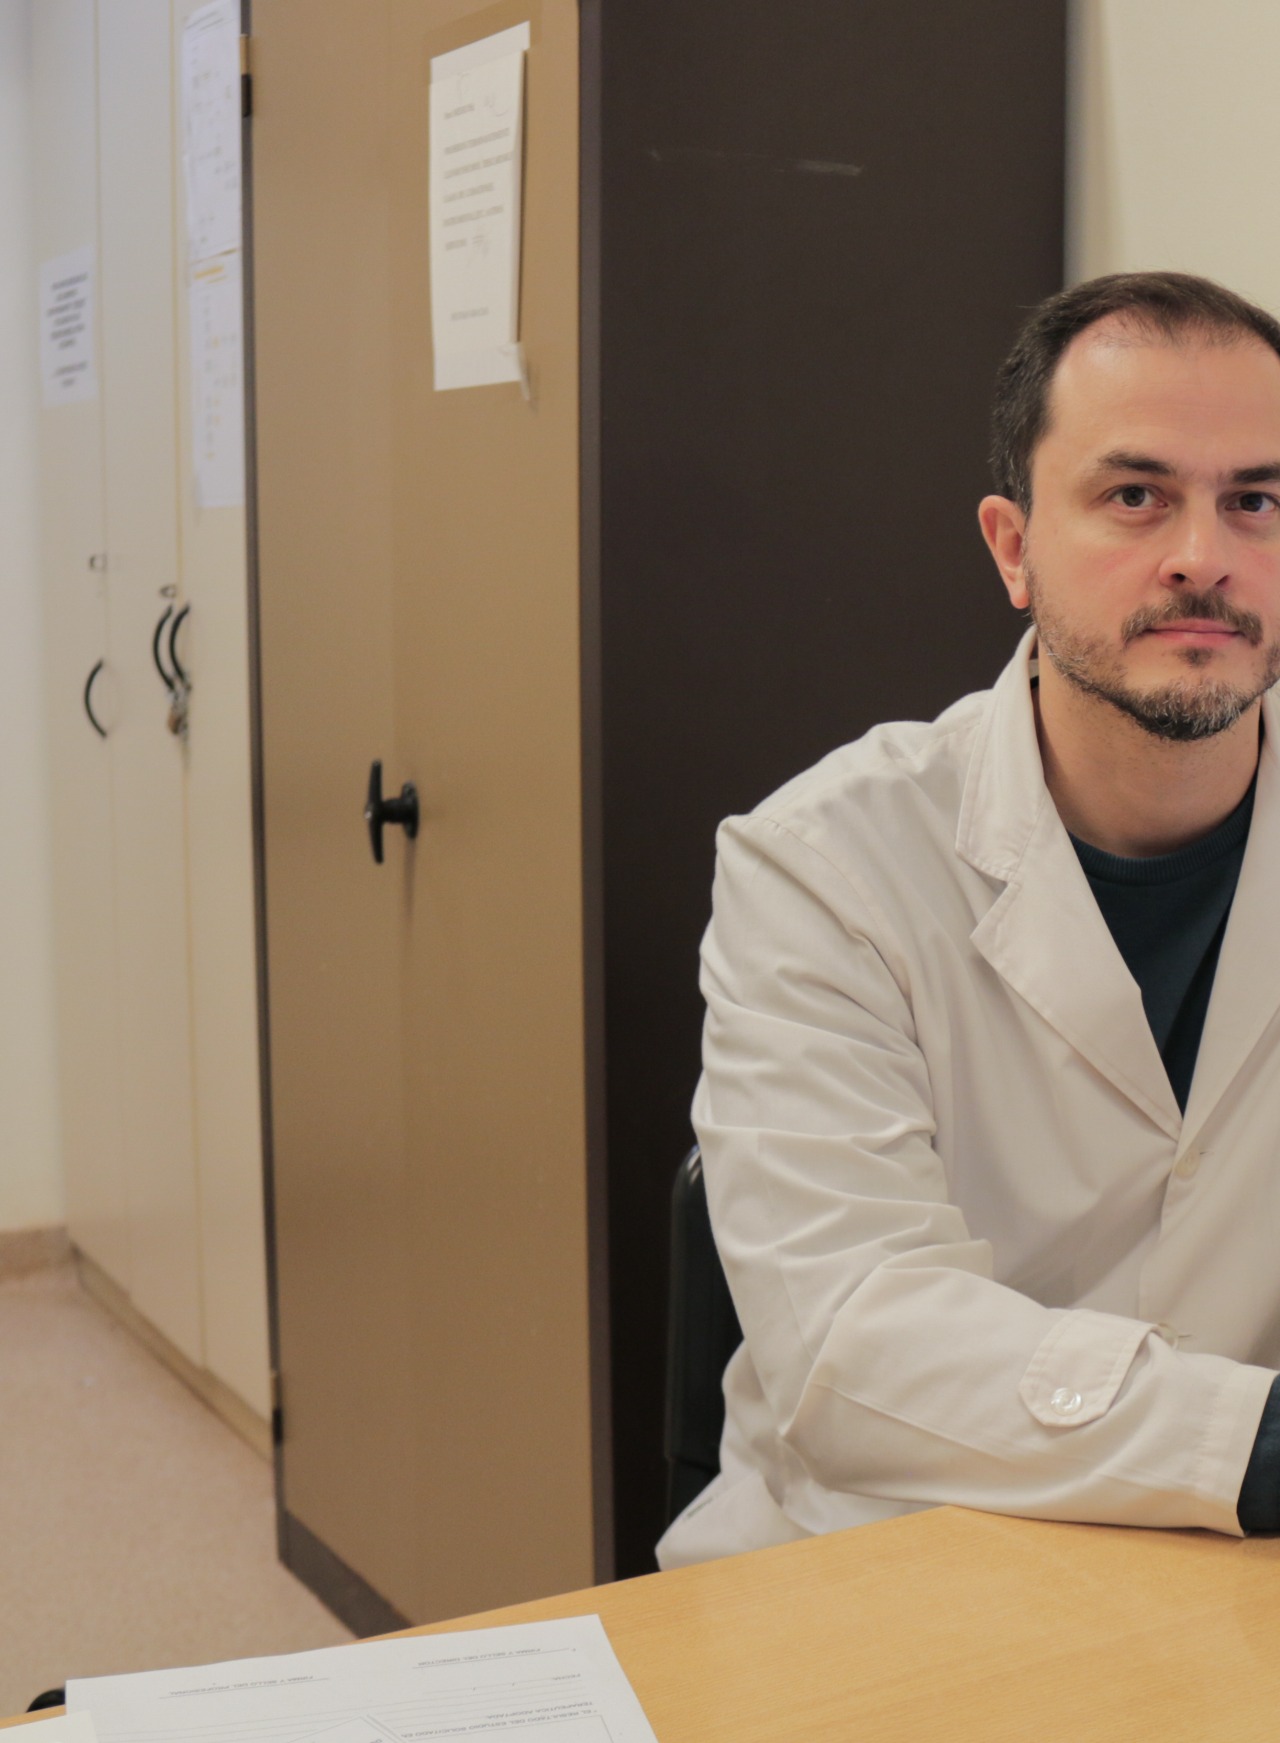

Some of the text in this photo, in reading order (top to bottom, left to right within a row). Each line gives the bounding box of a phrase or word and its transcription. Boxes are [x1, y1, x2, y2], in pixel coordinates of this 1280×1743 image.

[527, 1711, 580, 1723] RESULTADO
[468, 1721, 507, 1730] ESTUDIO
[415, 1727, 467, 1737] SOLICITADO
